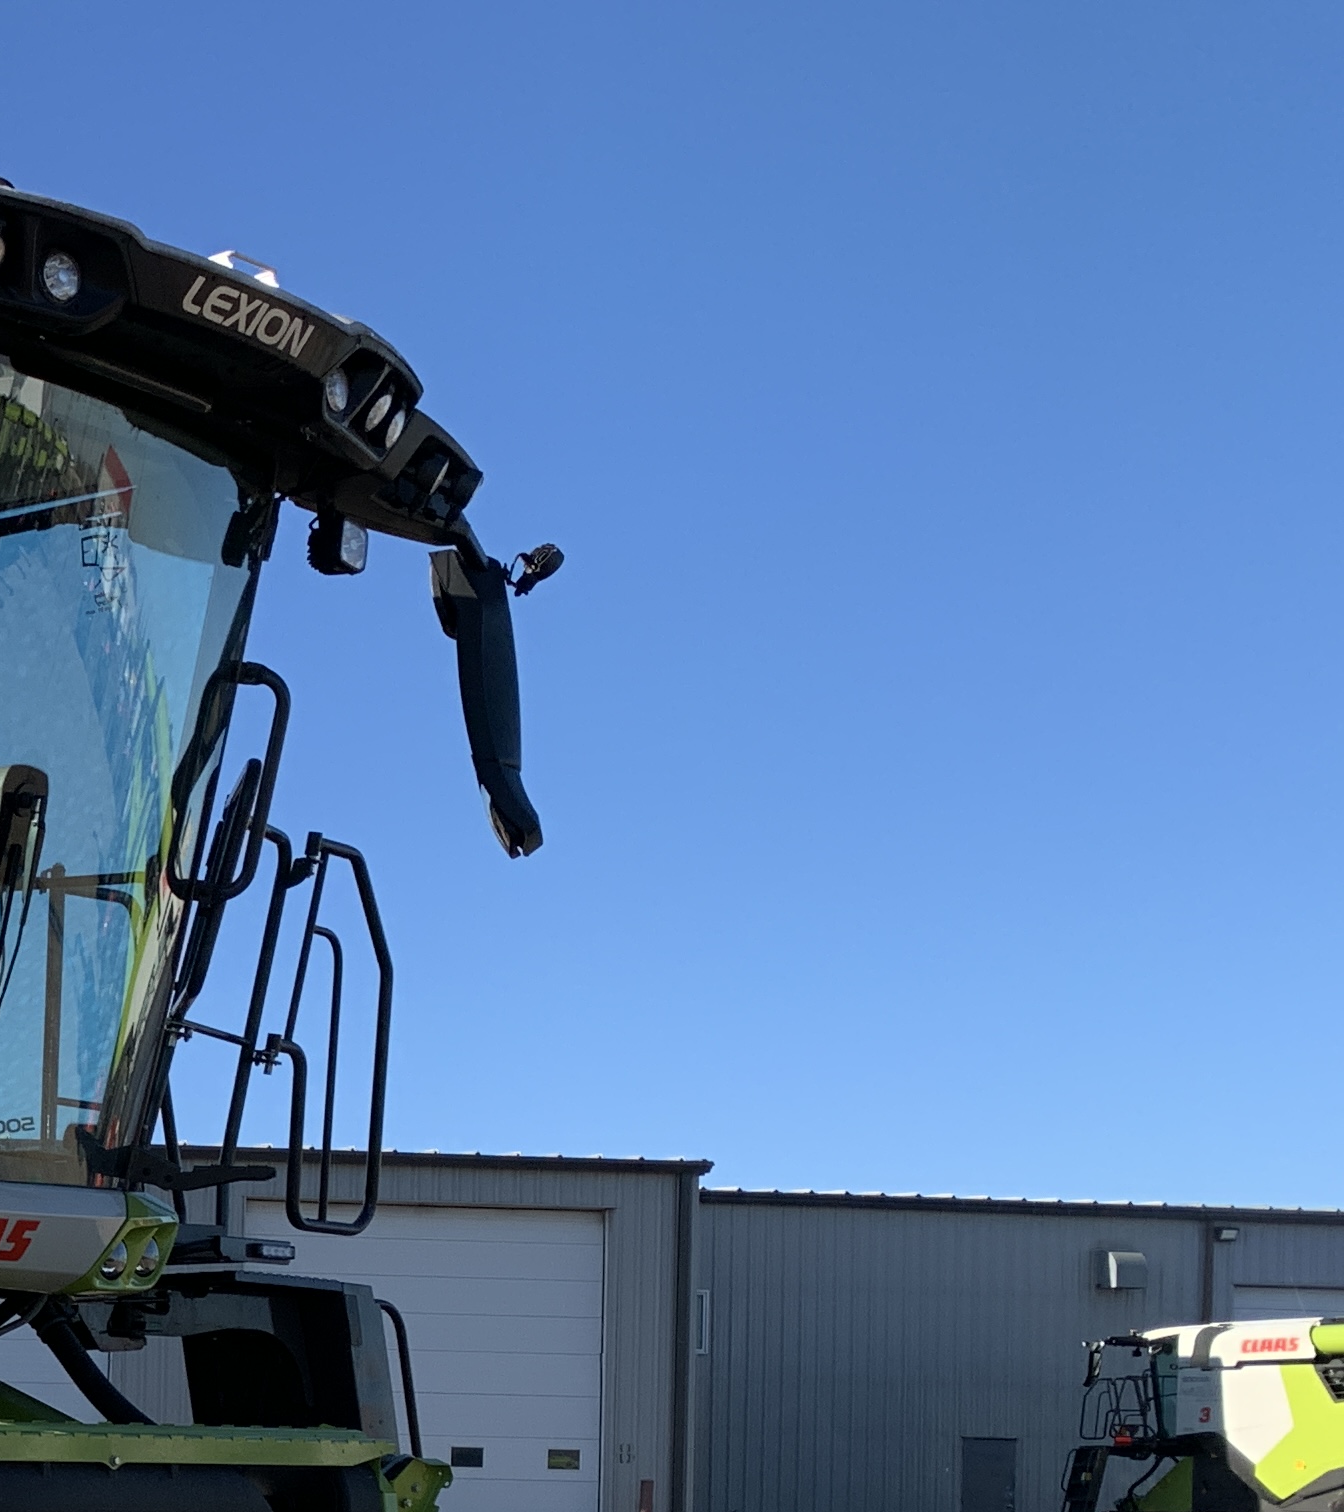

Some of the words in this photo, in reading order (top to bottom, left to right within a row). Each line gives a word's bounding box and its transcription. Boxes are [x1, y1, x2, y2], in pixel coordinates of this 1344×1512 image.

[182, 275, 315, 358] LEXION
[1241, 1337, 1300, 1353] CLAAS
[1198, 1406, 1211, 1423] 3
